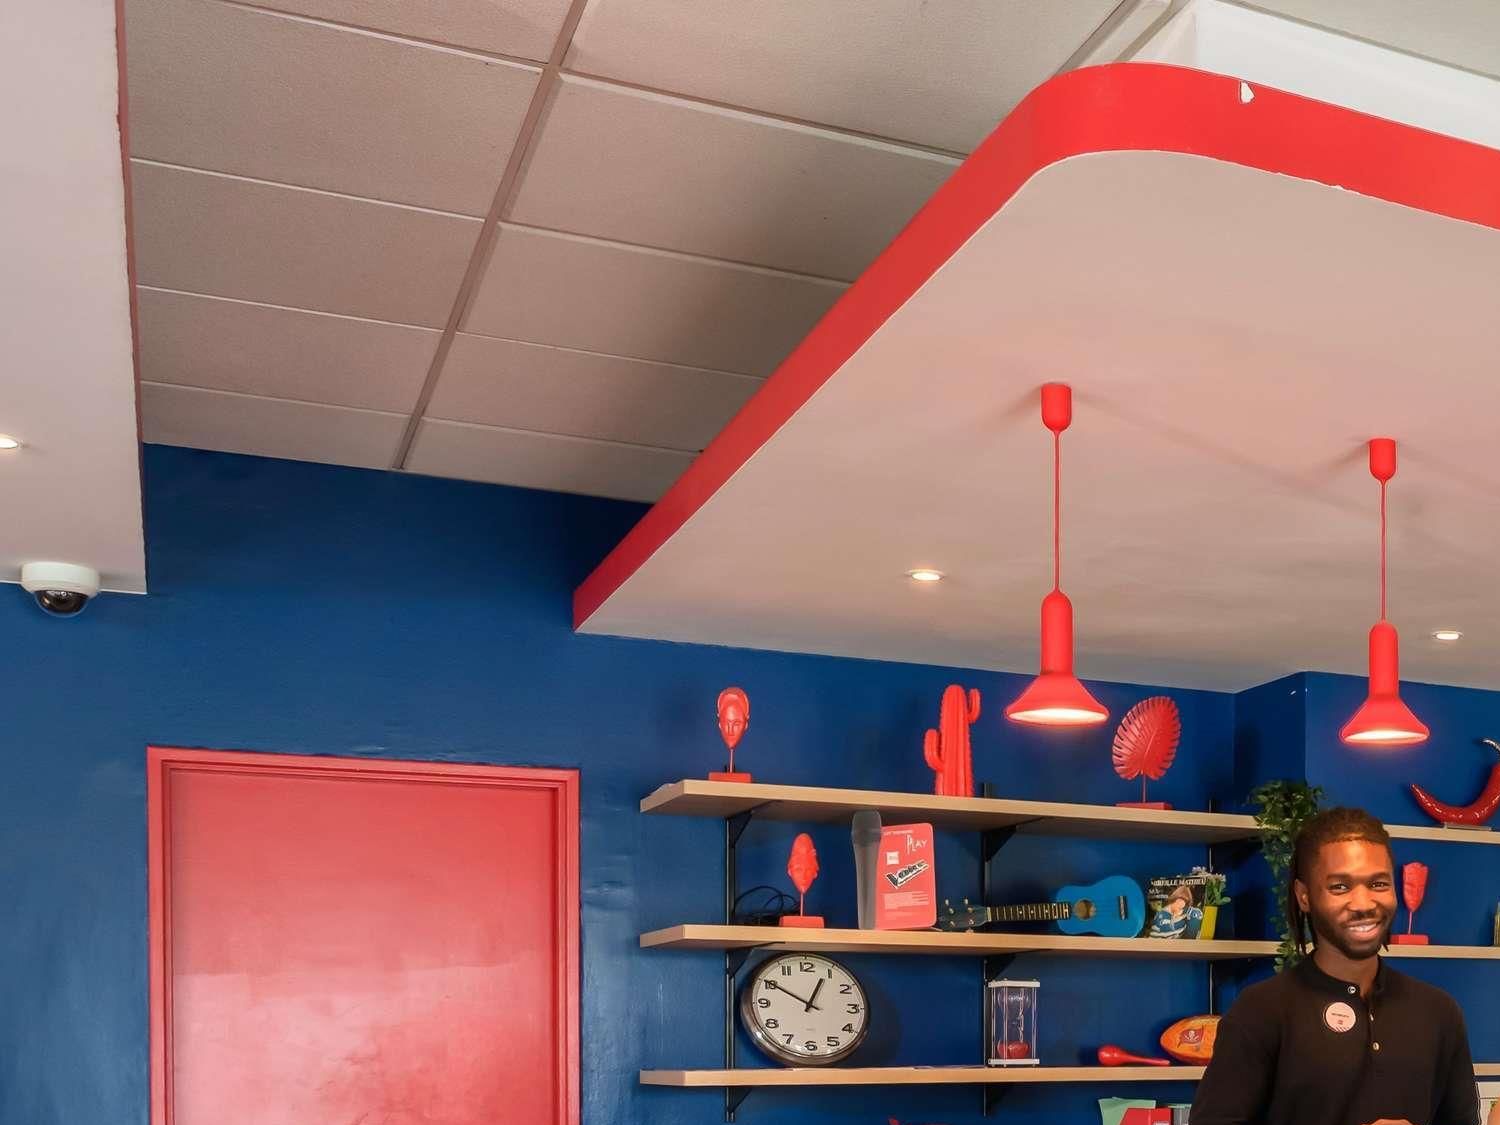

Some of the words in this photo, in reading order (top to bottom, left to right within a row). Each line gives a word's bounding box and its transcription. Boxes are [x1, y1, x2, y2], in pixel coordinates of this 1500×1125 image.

[906, 834, 928, 855] PLAY
[781, 965, 792, 976] 11
[799, 961, 816, 973] 12
[826, 968, 833, 979] 1
[839, 983, 853, 995] 2
[757, 998, 771, 1009] 9
[846, 1003, 860, 1014] 3
[765, 1018, 779, 1029] 8
[841, 1023, 855, 1034] 4
[782, 1033, 795, 1045] 7
[826, 1036, 840, 1048] 5
[804, 1040, 818, 1051] 6
